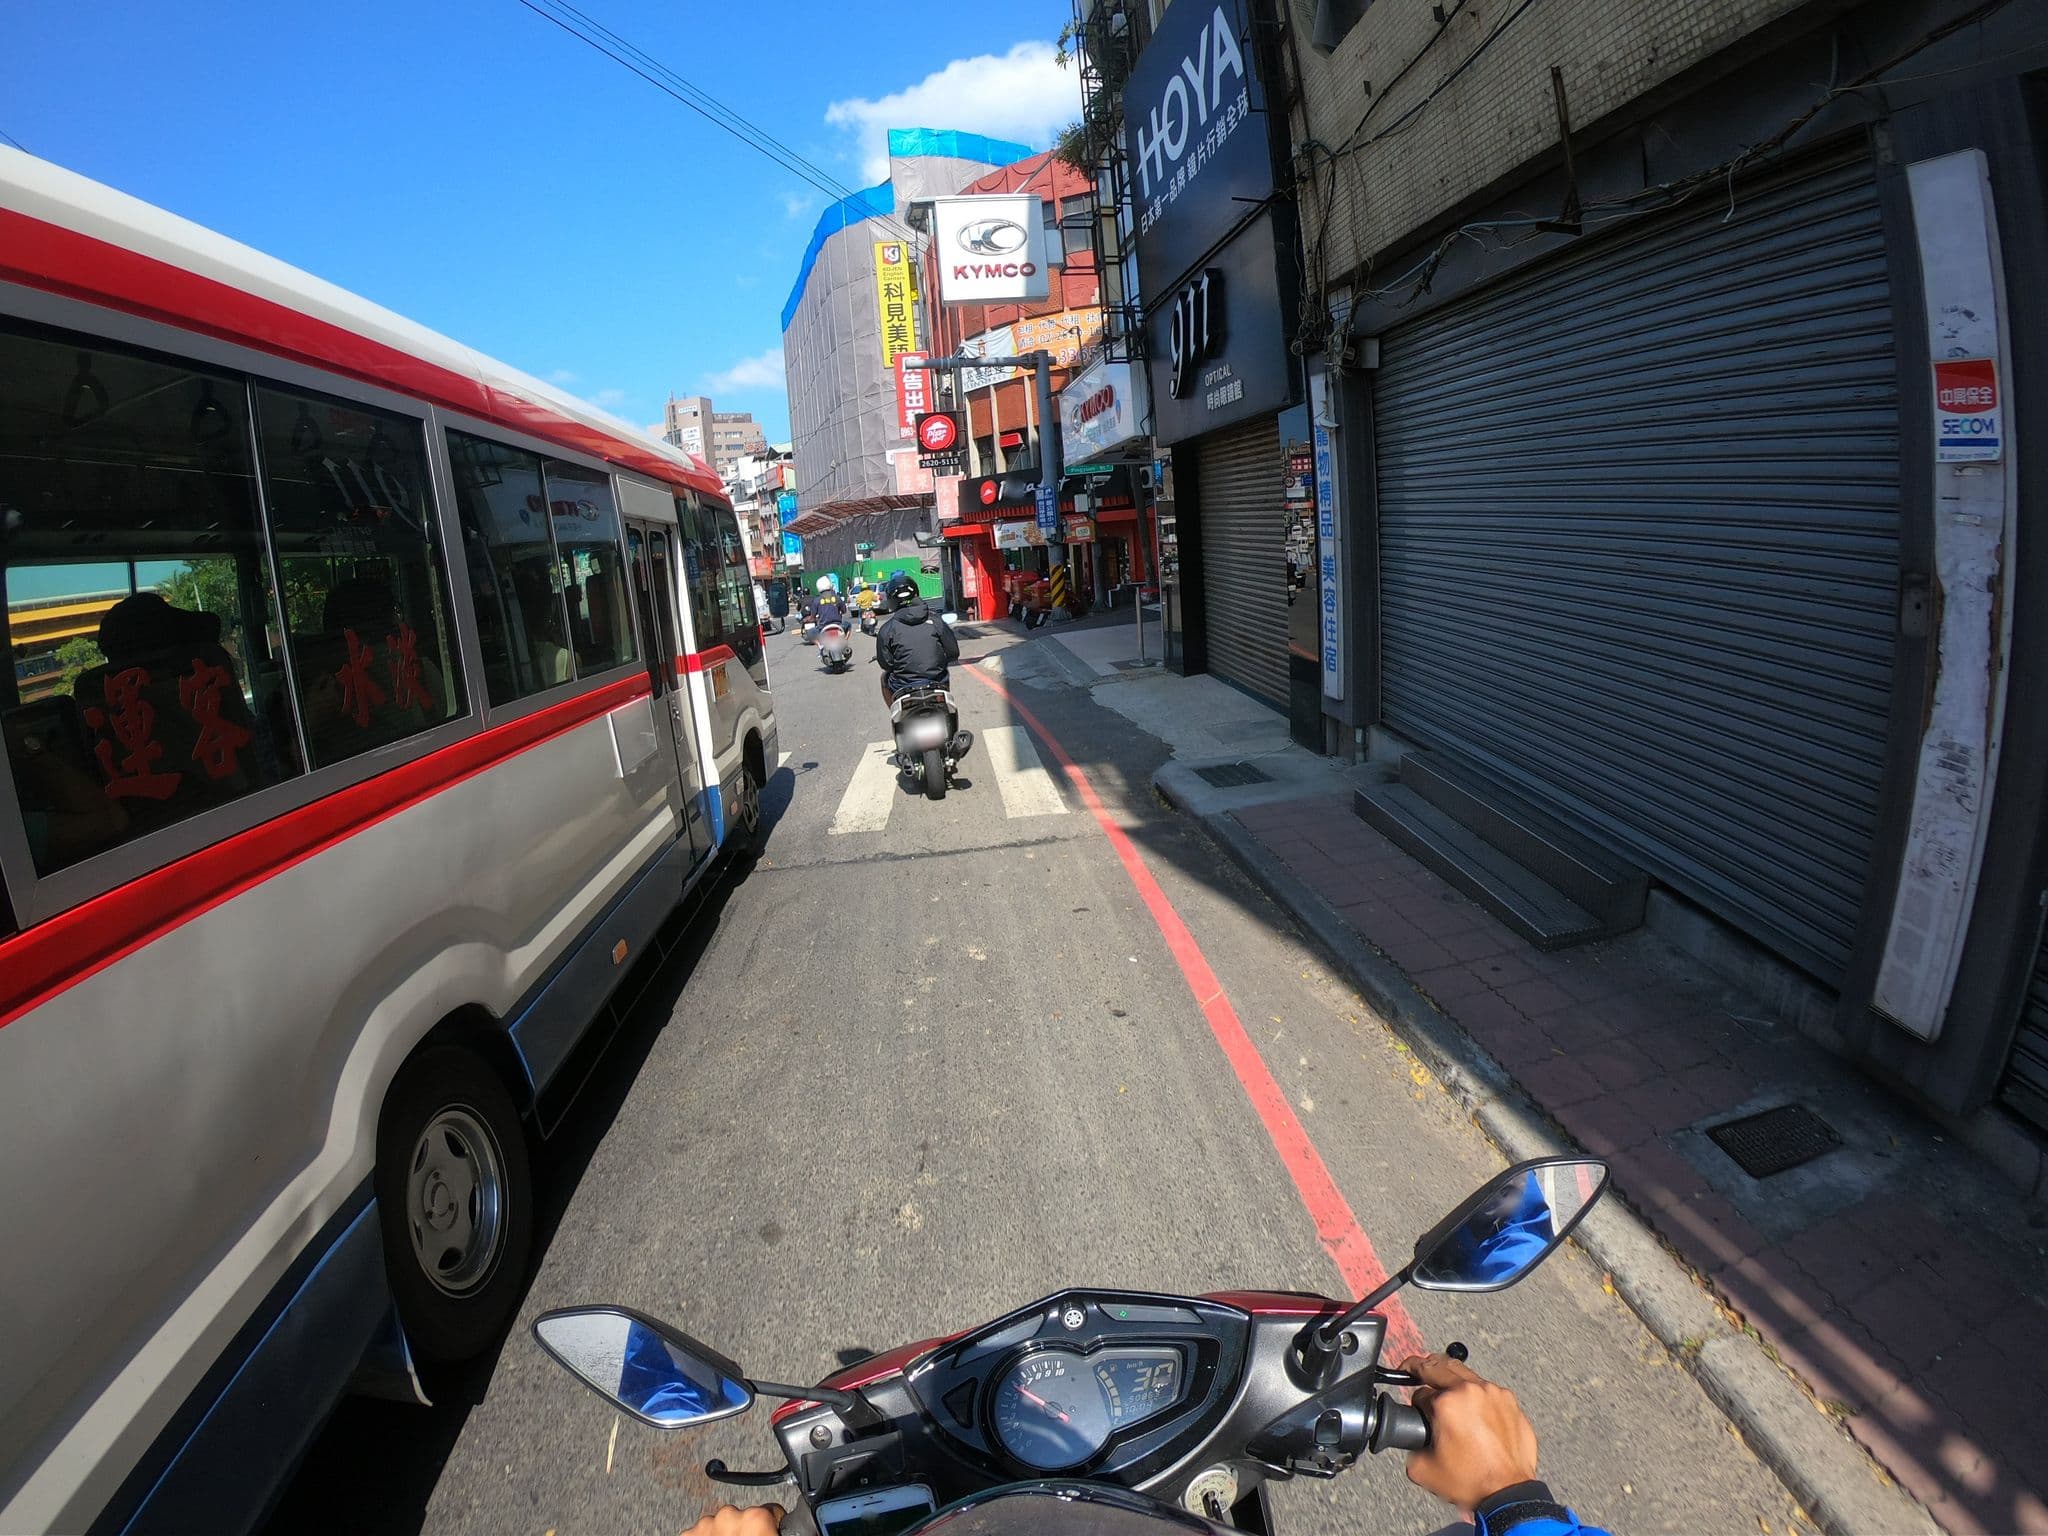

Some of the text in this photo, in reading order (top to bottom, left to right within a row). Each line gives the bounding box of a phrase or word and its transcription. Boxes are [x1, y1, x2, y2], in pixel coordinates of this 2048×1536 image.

[1136, 5, 1244, 199] HOYA
[1140, 87, 1249, 237] 日本第一品牌 鏡片行銷全球
[953, 262, 1036, 280] KYMCO
[1169, 269, 1213, 400] 911
[1204, 363, 1232, 387] OPTICAL
[1942, 418, 1995, 434] SECOM
[921, 458, 959, 468] 2620-5115
[1027, 1368, 1065, 1386] 7 8 9 10
